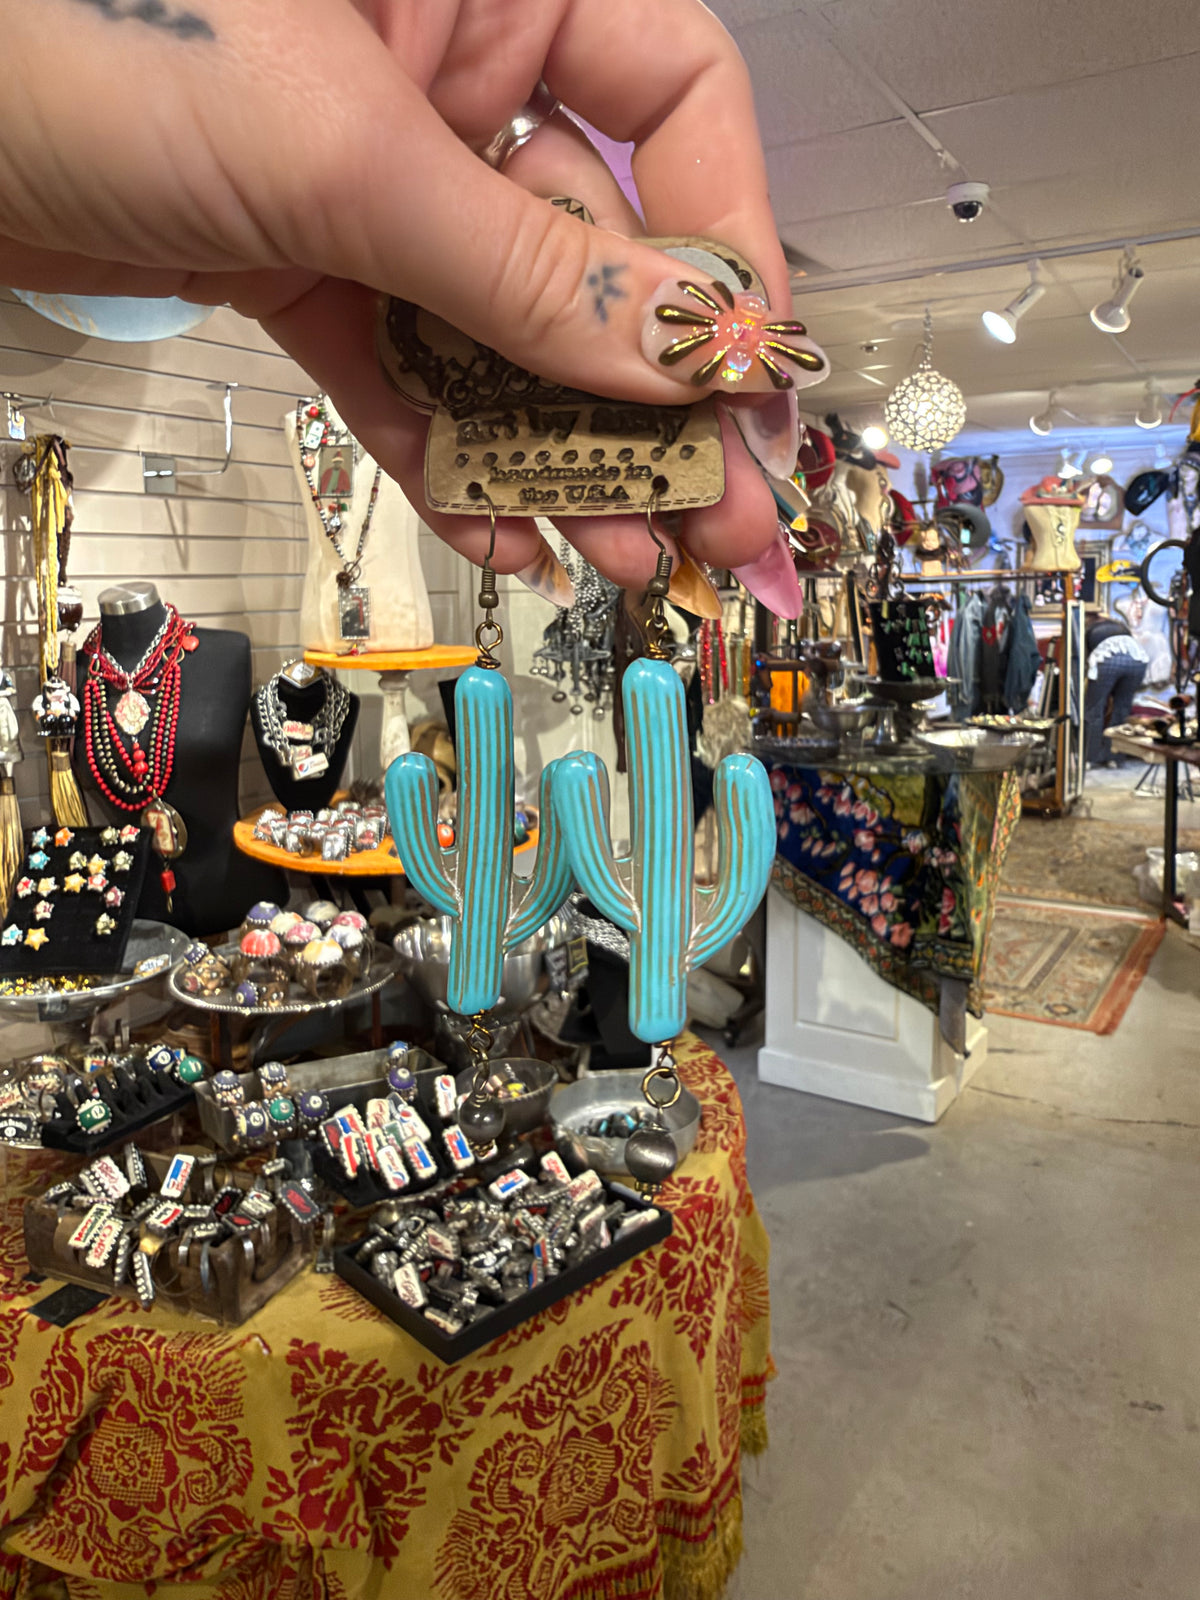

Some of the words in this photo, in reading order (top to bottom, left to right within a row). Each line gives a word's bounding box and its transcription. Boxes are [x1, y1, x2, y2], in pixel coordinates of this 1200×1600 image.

[489, 464, 620, 483] handmade
[625, 463, 654, 480] in
[519, 487, 559, 504] the
[563, 485, 630, 503] USA
